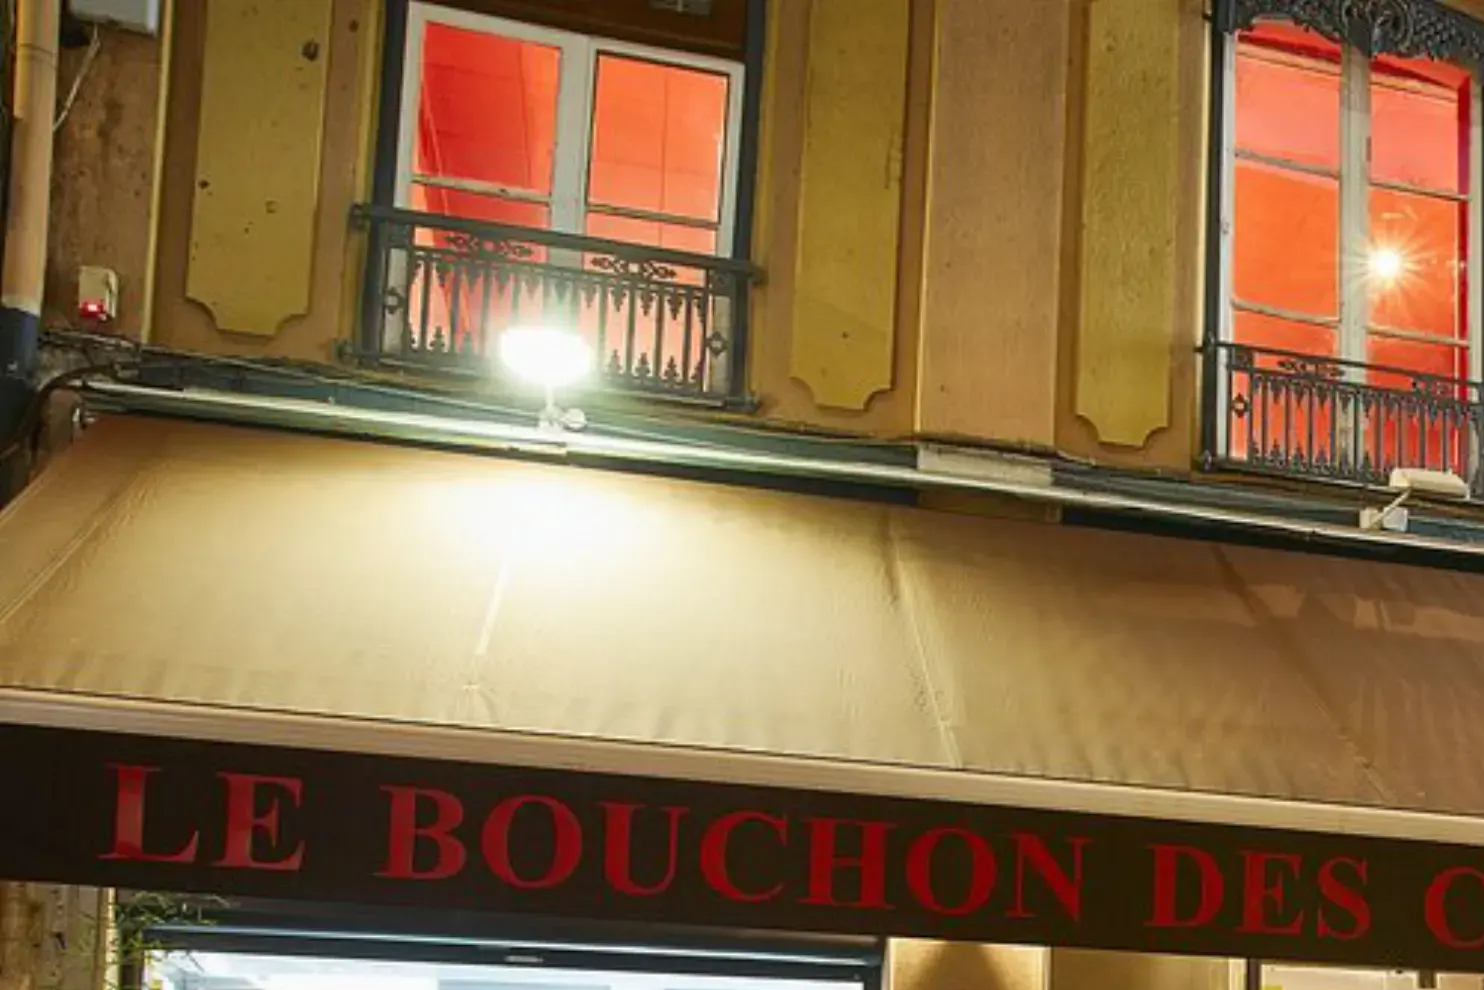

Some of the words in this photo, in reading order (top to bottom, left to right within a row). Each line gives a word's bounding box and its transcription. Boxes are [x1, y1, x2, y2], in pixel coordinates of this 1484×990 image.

[99, 763, 306, 871] LE
[374, 784, 1093, 925] BOUCHON
[1142, 843, 1373, 943] DES
